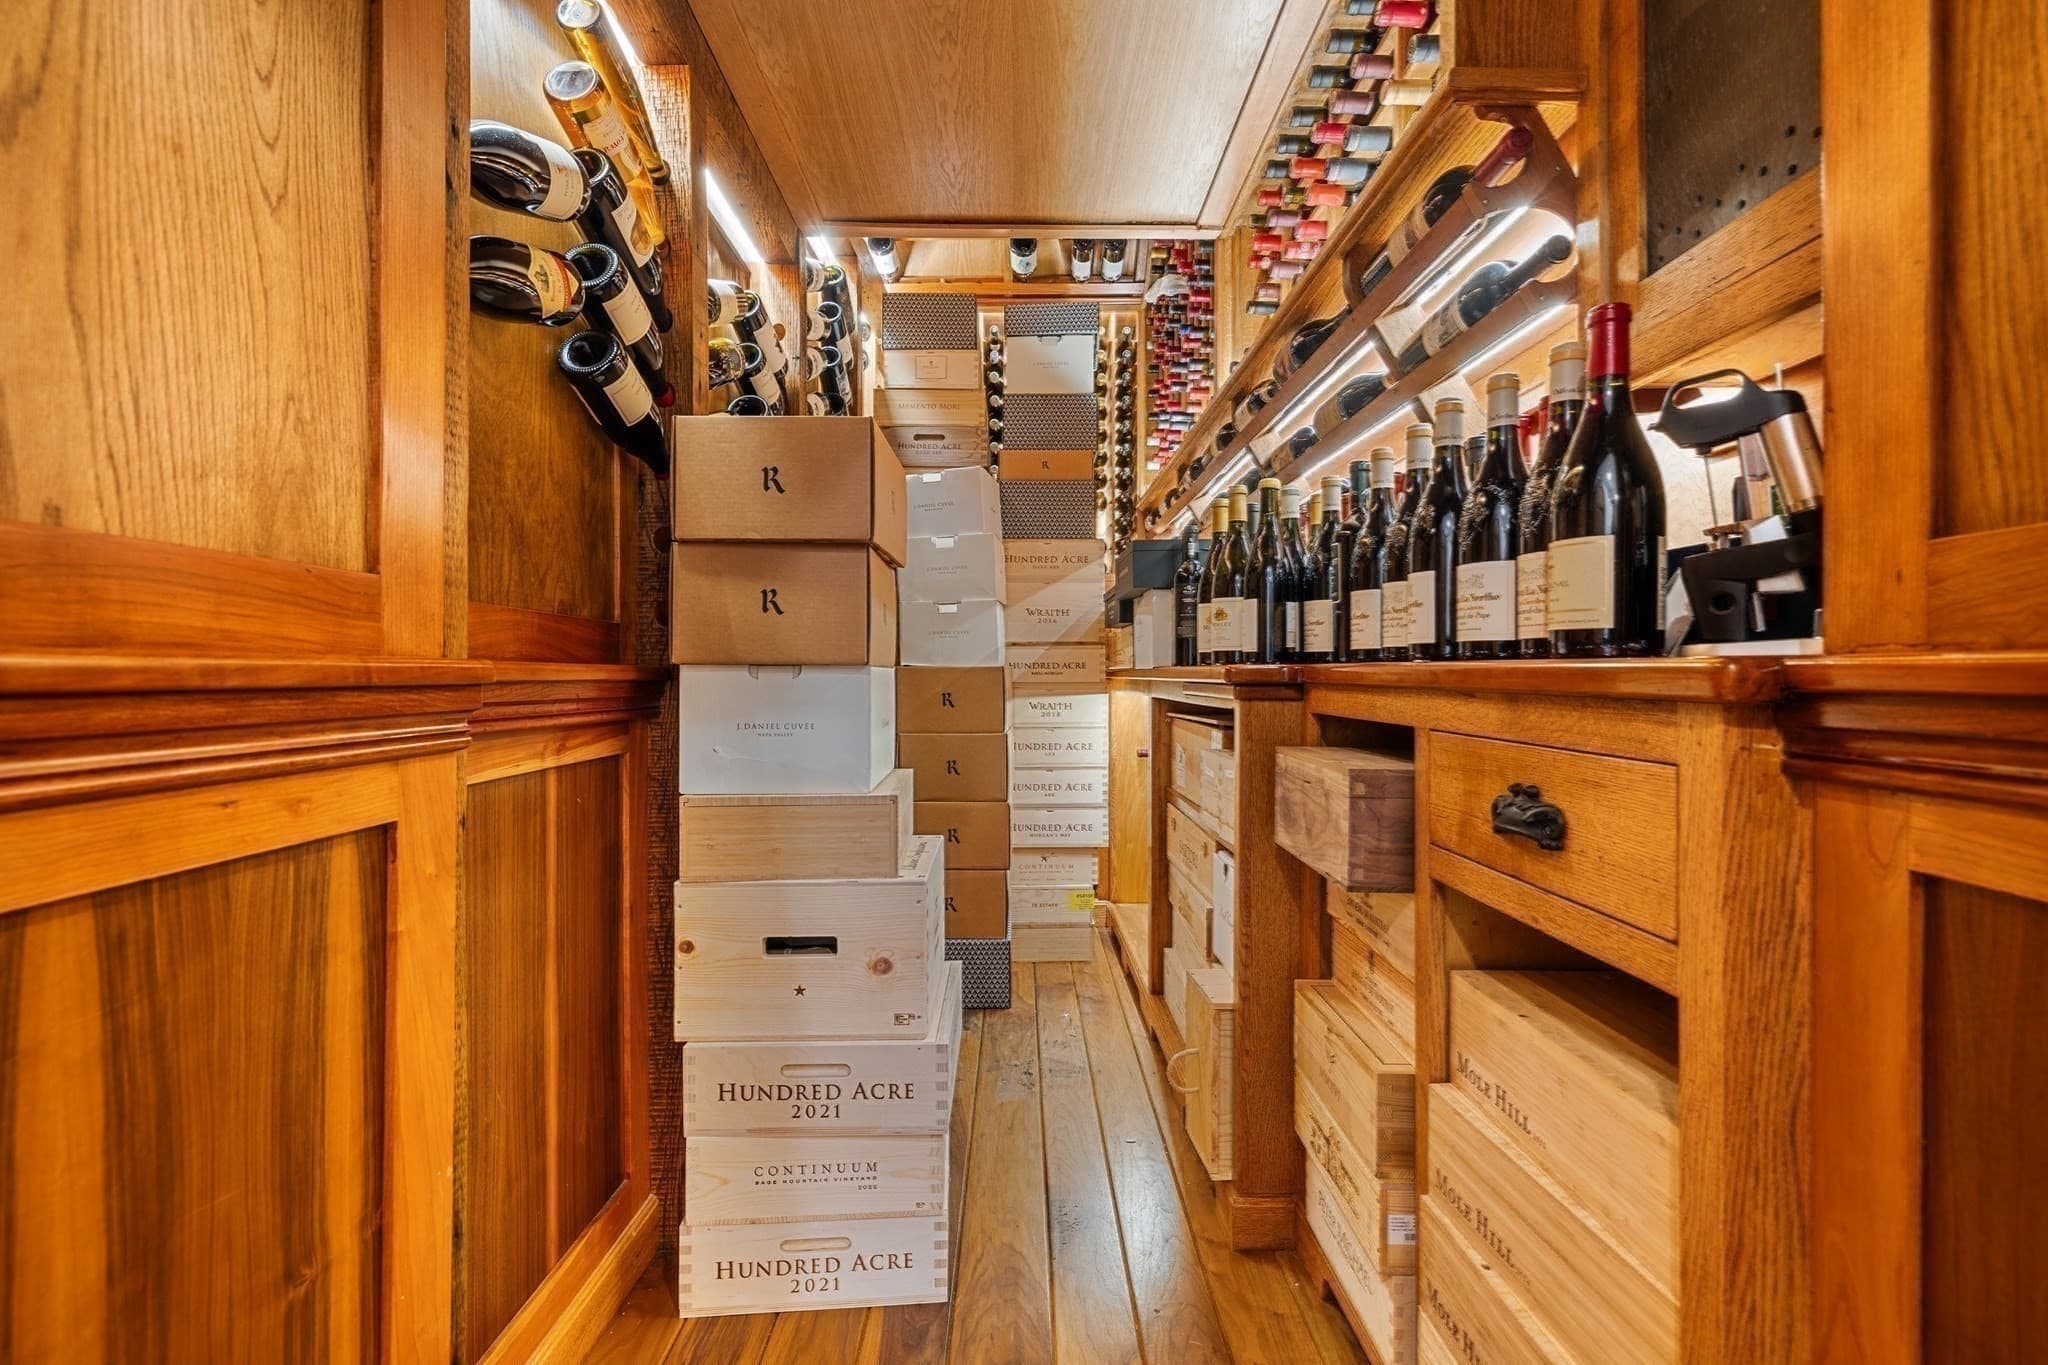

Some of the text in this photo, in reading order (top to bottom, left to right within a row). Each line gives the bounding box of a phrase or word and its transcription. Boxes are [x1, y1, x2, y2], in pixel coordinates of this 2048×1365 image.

[897, 442, 938, 450] HUNDRED
[1041, 460, 1050, 470] R
[761, 466, 786, 495] R
[1004, 554, 1089, 564] HUNDRED ACRE
[760, 588, 785, 616] R
[1025, 607, 1070, 617] WRAITH
[1008, 662, 1088, 670] HUNDRED ACRE
[941, 692, 955, 708] R
[1028, 701, 1073, 711] WRAITH
[744, 722, 781, 730] DANIEL
[1065, 742, 1094, 751] ACRE
[946, 759, 961, 777] R
[1064, 783, 1093, 792] ACRE
[1065, 823, 1093, 832] ACRE
[947, 828, 960, 845] R
[945, 896, 957, 912] R
[717, 1082, 914, 1101] HUNDRED ACRE
[1456, 1050, 1531, 1135] MOLE HILL
[791, 1104, 841, 1119] 2021
[753, 1161, 879, 1177] CONTINUUM
[782, 1177, 829, 1185] MOUNTAIN
[1475, 1207, 1515, 1268] HILL
[715, 1252, 914, 1280] HUNDRED ACRE
[790, 1277, 840, 1294] 2021
